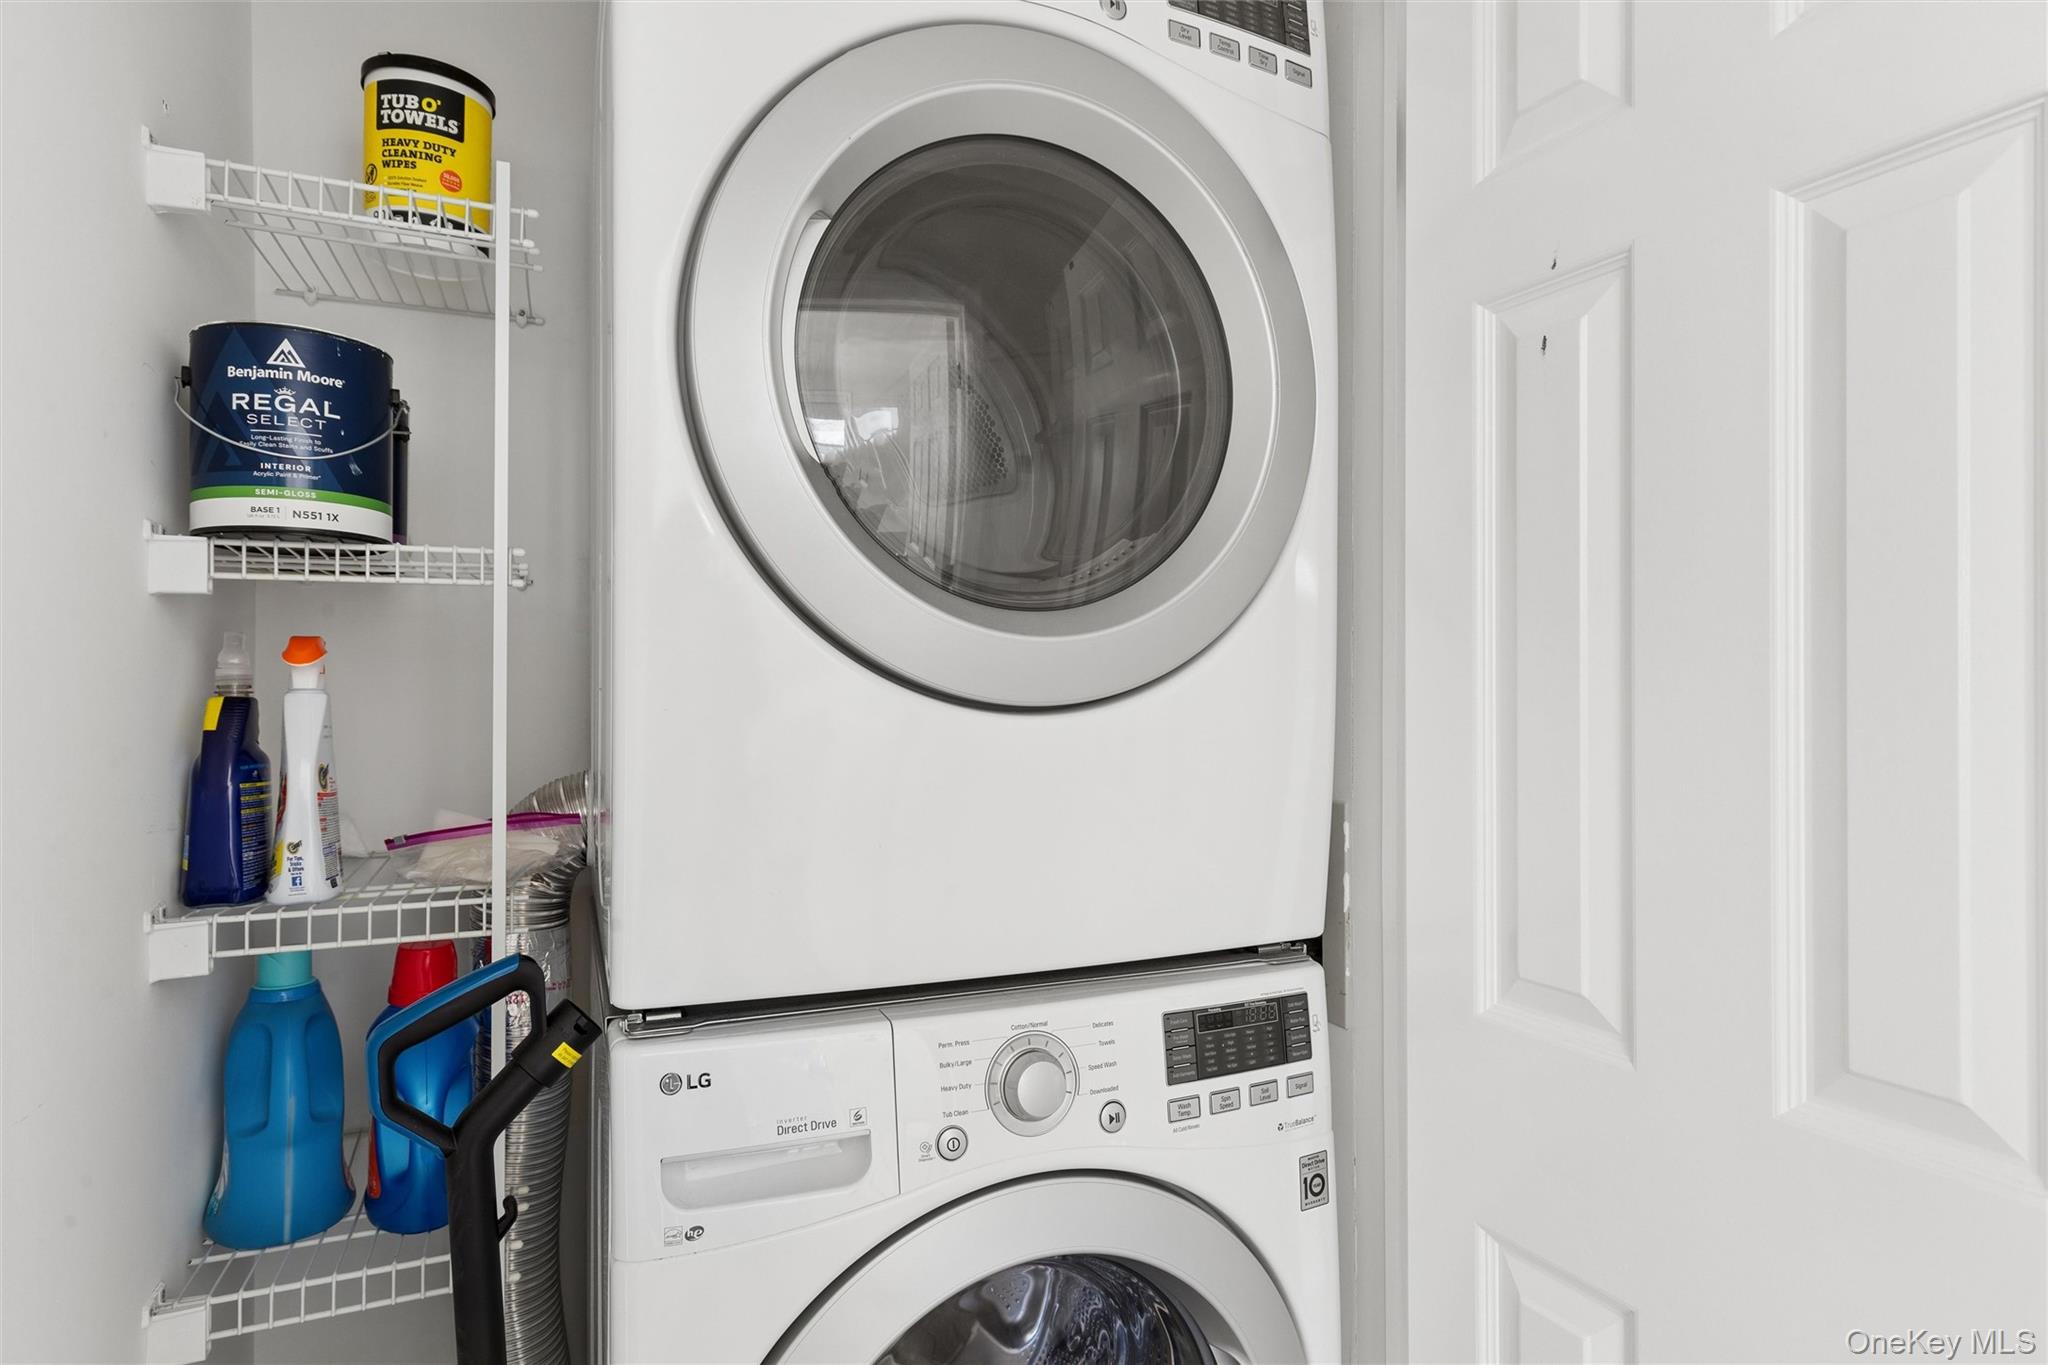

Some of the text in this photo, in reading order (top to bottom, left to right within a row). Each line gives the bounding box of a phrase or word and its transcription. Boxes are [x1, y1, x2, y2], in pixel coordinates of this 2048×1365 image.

[380, 93, 420, 109] TUB
[380, 108, 459, 135] TOWELS
[382, 138, 457, 157] HEAVY DUTY
[382, 149, 443, 163] CLEANING
[382, 160, 417, 169] WIPES
[227, 365, 343, 388] Benjamin Moore
[232, 393, 341, 420] REGAL
[246, 413, 328, 430] SELECT
[250, 434, 292, 442] Long-Lasting
[294, 437, 313, 445] Finish
[260, 462, 312, 473] INTERIOR
[255, 488, 317, 499] SEMI-GLOSS
[250, 506, 274, 514] BASE
[292, 510, 322, 521] N551
[1010, 1021, 1049, 1032] Cotton/Normal
[1092, 1021, 1114, 1029] Delicates
[955, 1039, 970, 1047] Press
[1098, 1039, 1116, 1047] Towels
[939, 1059, 973, 1070] Bulky/Large
[1088, 1063, 1104, 1071] Speed
[686, 1073, 712, 1090] LG
[940, 1082, 972, 1093] Heavy Duty
[1089, 1085, 1119, 1096] Downloaded
[1220, 1095, 1232, 1103] Spin
[1177, 1102, 1192, 1110] Wash
[1219, 1102, 1234, 1111] Speed
[942, 1109, 969, 1119] Tub Clean
[776, 1116, 808, 1125] inverter
[776, 1119, 838, 1136] Direct Drive
[1303, 1173, 1325, 1200] 10
